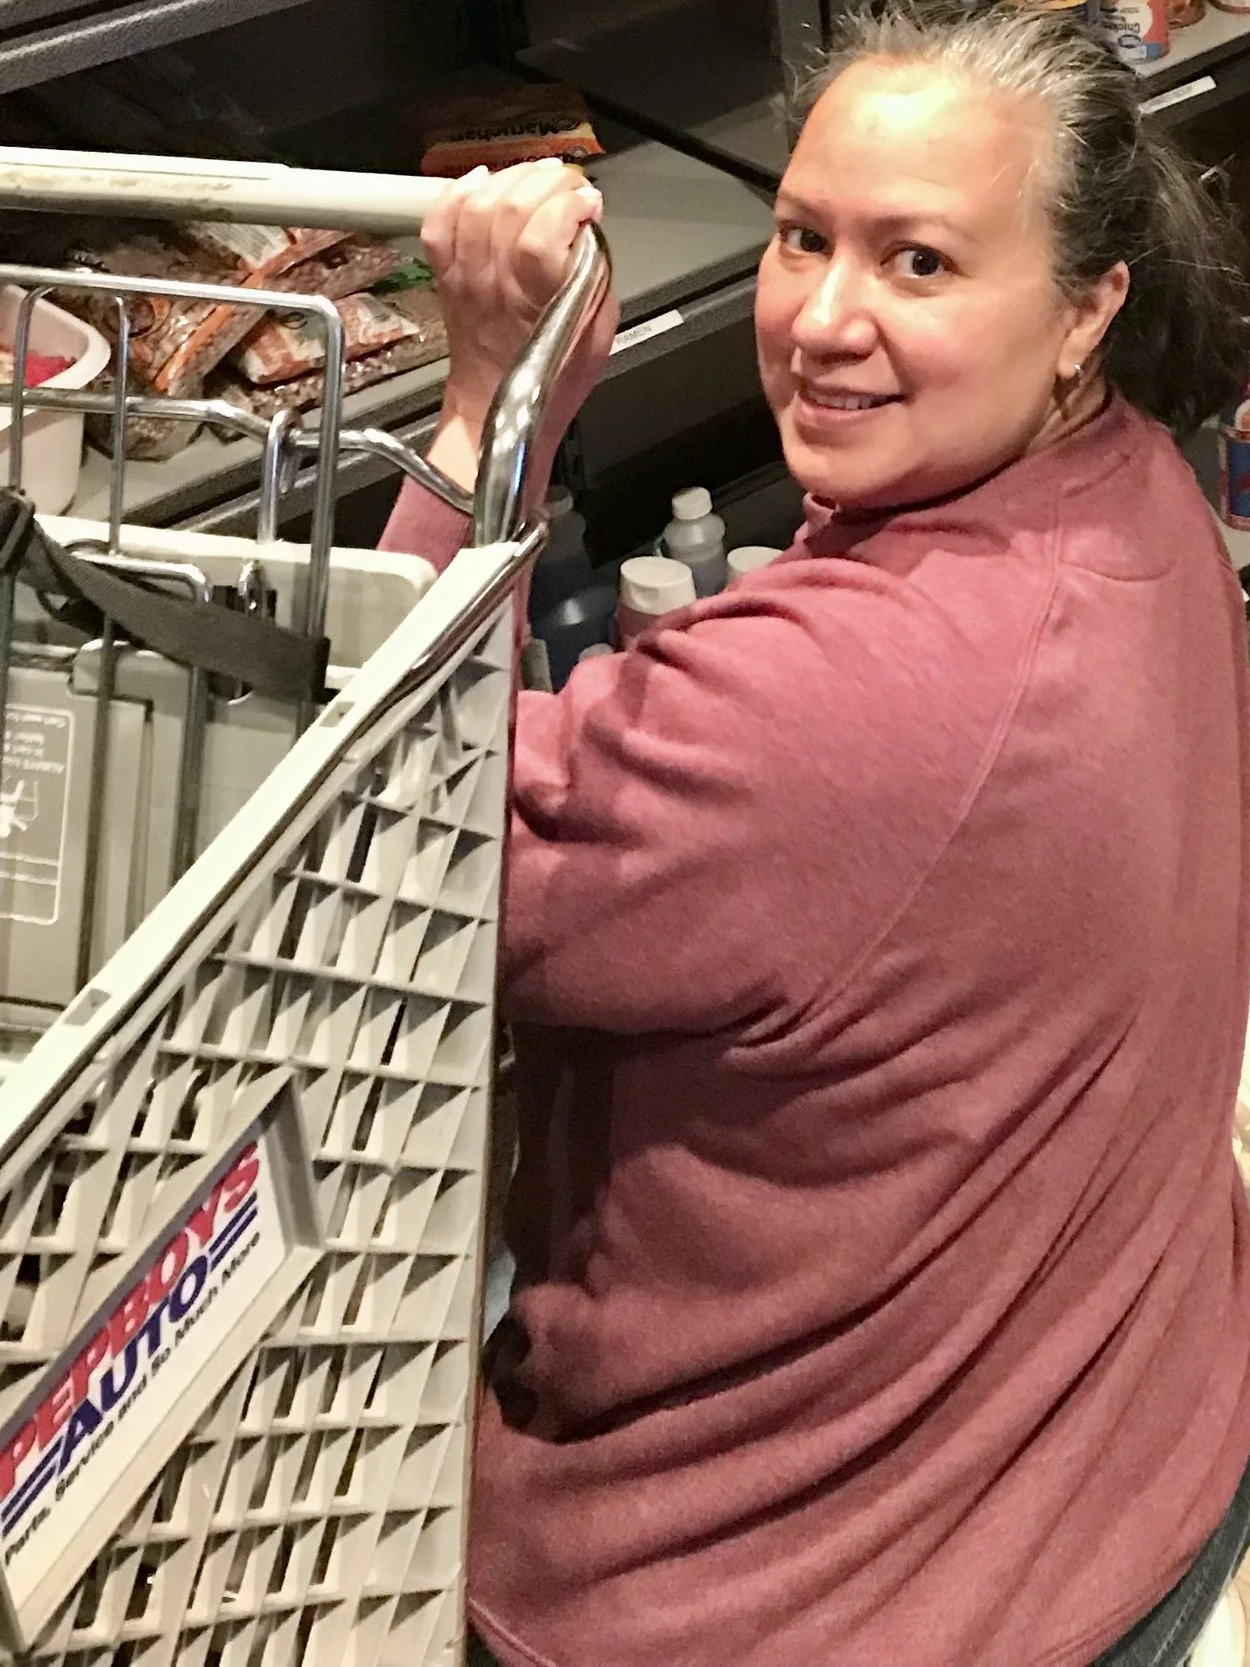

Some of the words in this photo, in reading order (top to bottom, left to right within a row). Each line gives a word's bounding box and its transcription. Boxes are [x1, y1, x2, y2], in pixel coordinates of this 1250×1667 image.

[55, 1440, 115, 1503] Service
[117, 1383, 148, 1422] and
[174, 1284, 219, 1340] Much
[221, 1231, 260, 1286] More
[58, 1254, 208, 1477] AUTO
